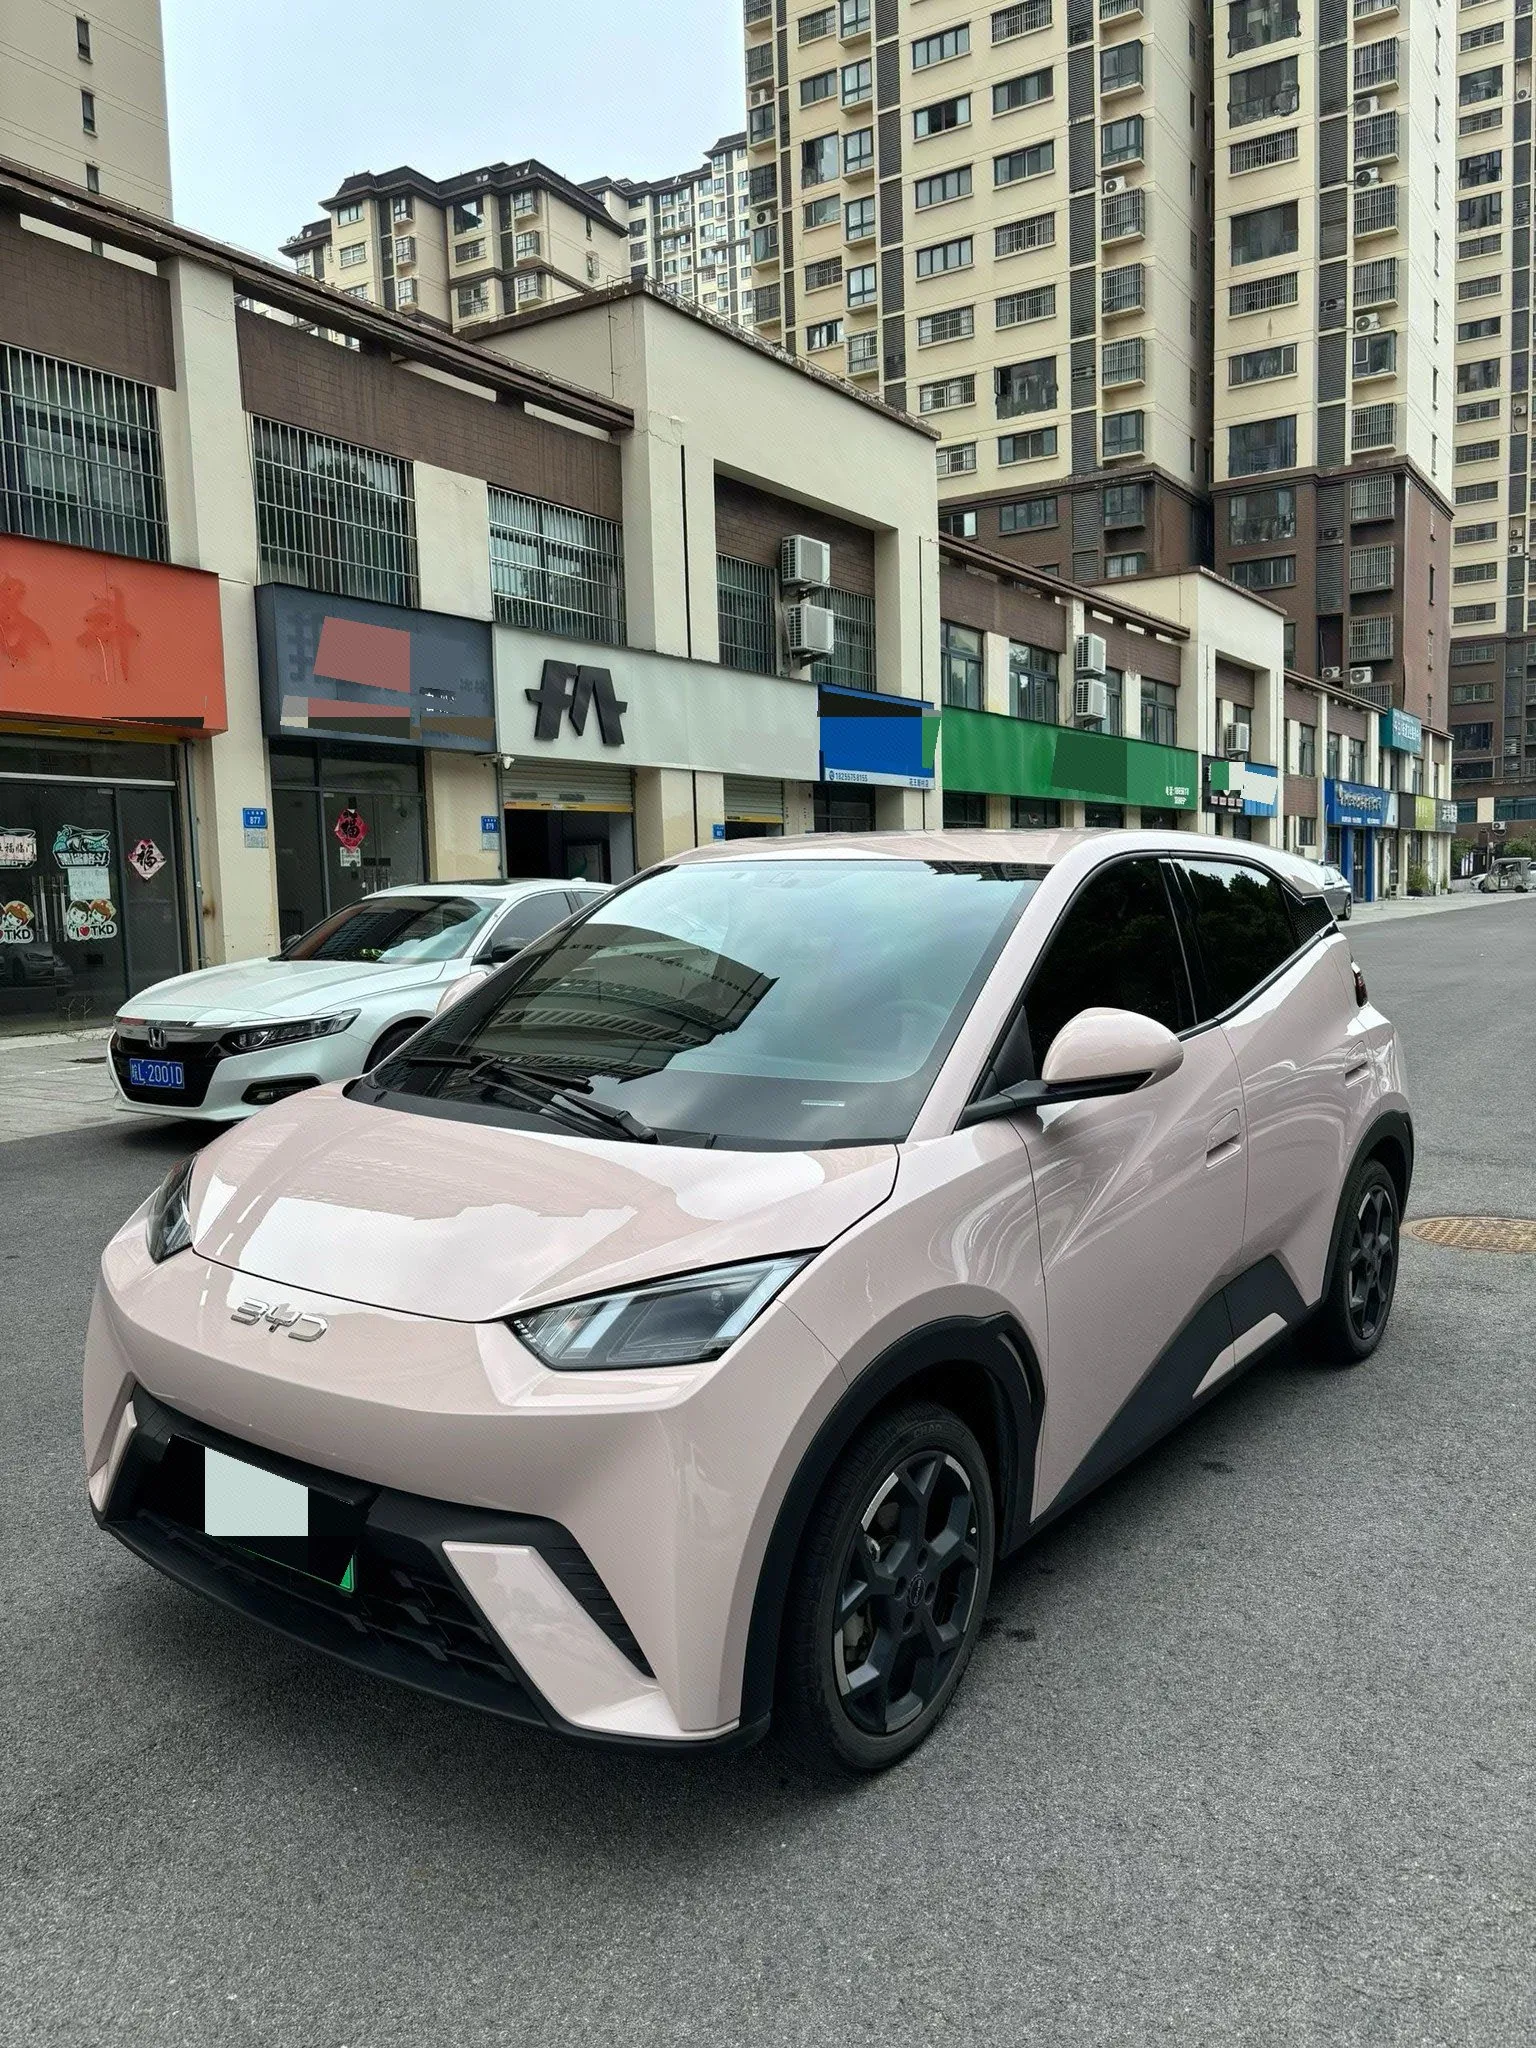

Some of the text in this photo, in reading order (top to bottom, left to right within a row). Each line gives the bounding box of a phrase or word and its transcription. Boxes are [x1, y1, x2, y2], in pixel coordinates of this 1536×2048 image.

[249, 816, 261, 825] 877
[136, 844, 158, 871] 福
[4, 929, 31, 940] TKD
[92, 924, 115, 936] TKD
[230, 1297, 329, 1342] BYD
